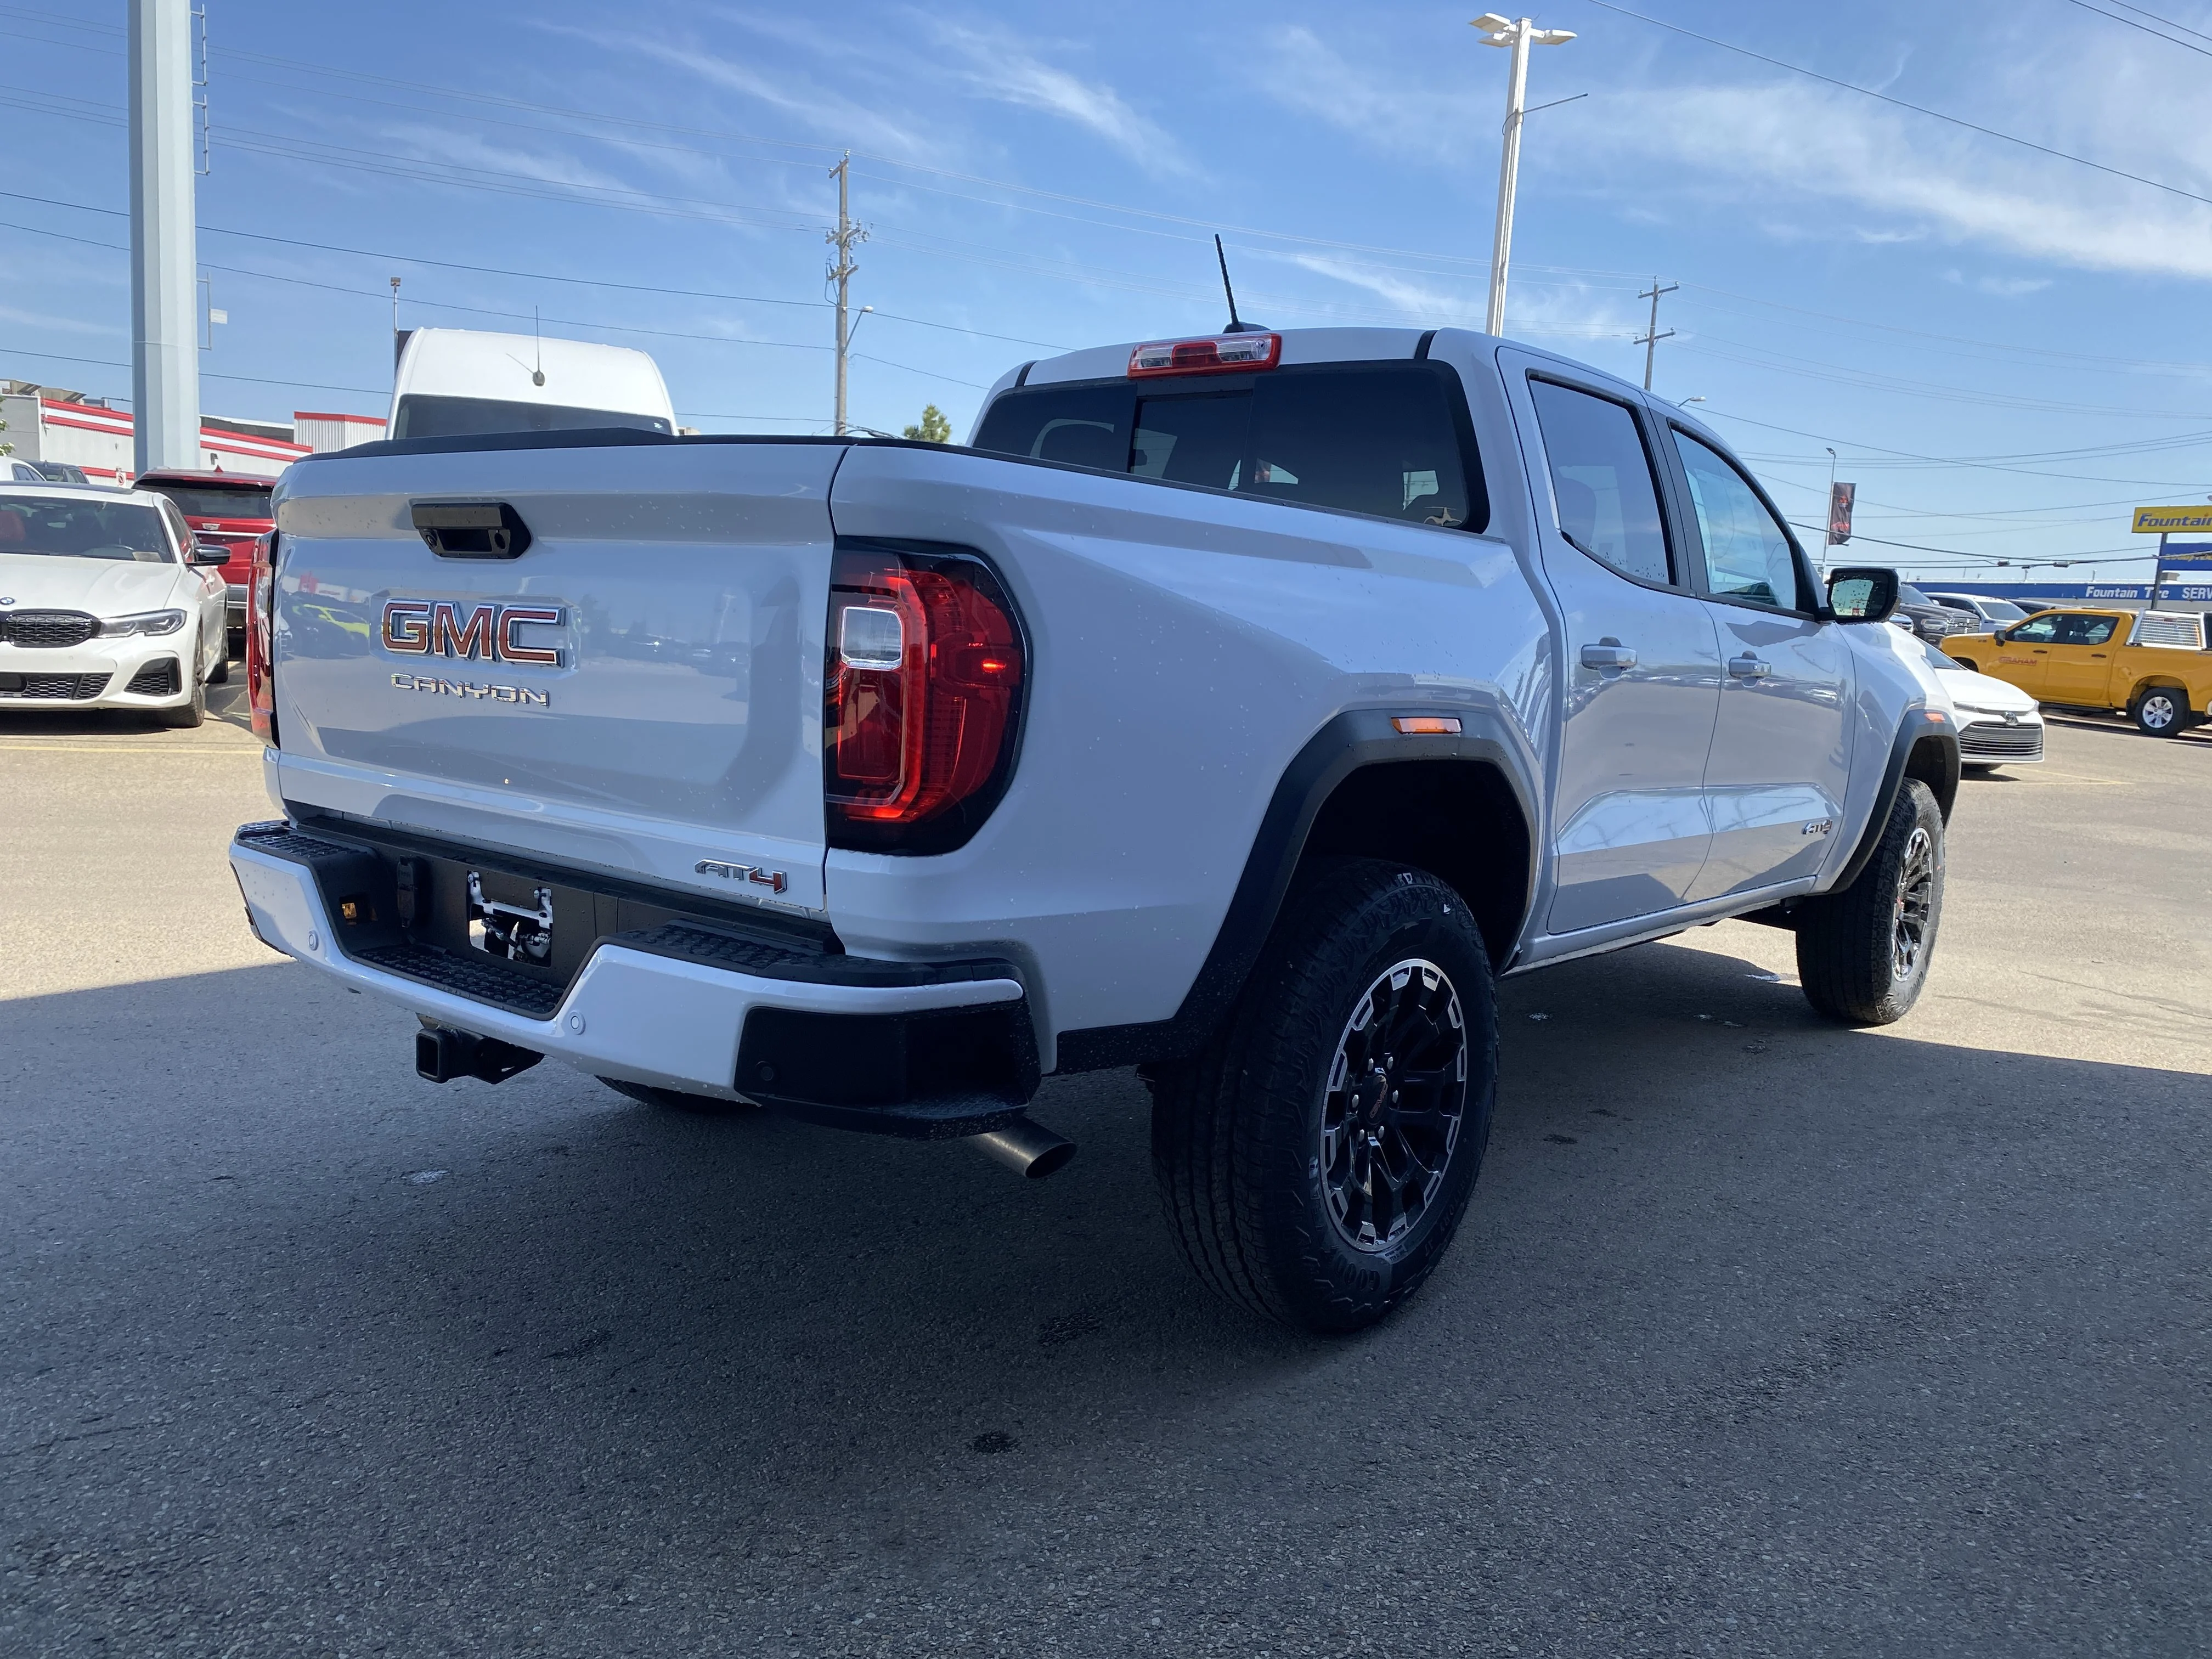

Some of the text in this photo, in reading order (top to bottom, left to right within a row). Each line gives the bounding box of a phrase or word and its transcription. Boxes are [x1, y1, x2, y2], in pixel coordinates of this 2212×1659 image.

[2085, 586, 2169, 598] Fountain Tre
[382, 598, 565, 667] GMC
[391, 673, 549, 708] CANYON
[1802, 819, 1832, 834] AT4
[695, 857, 787, 894] AT4
